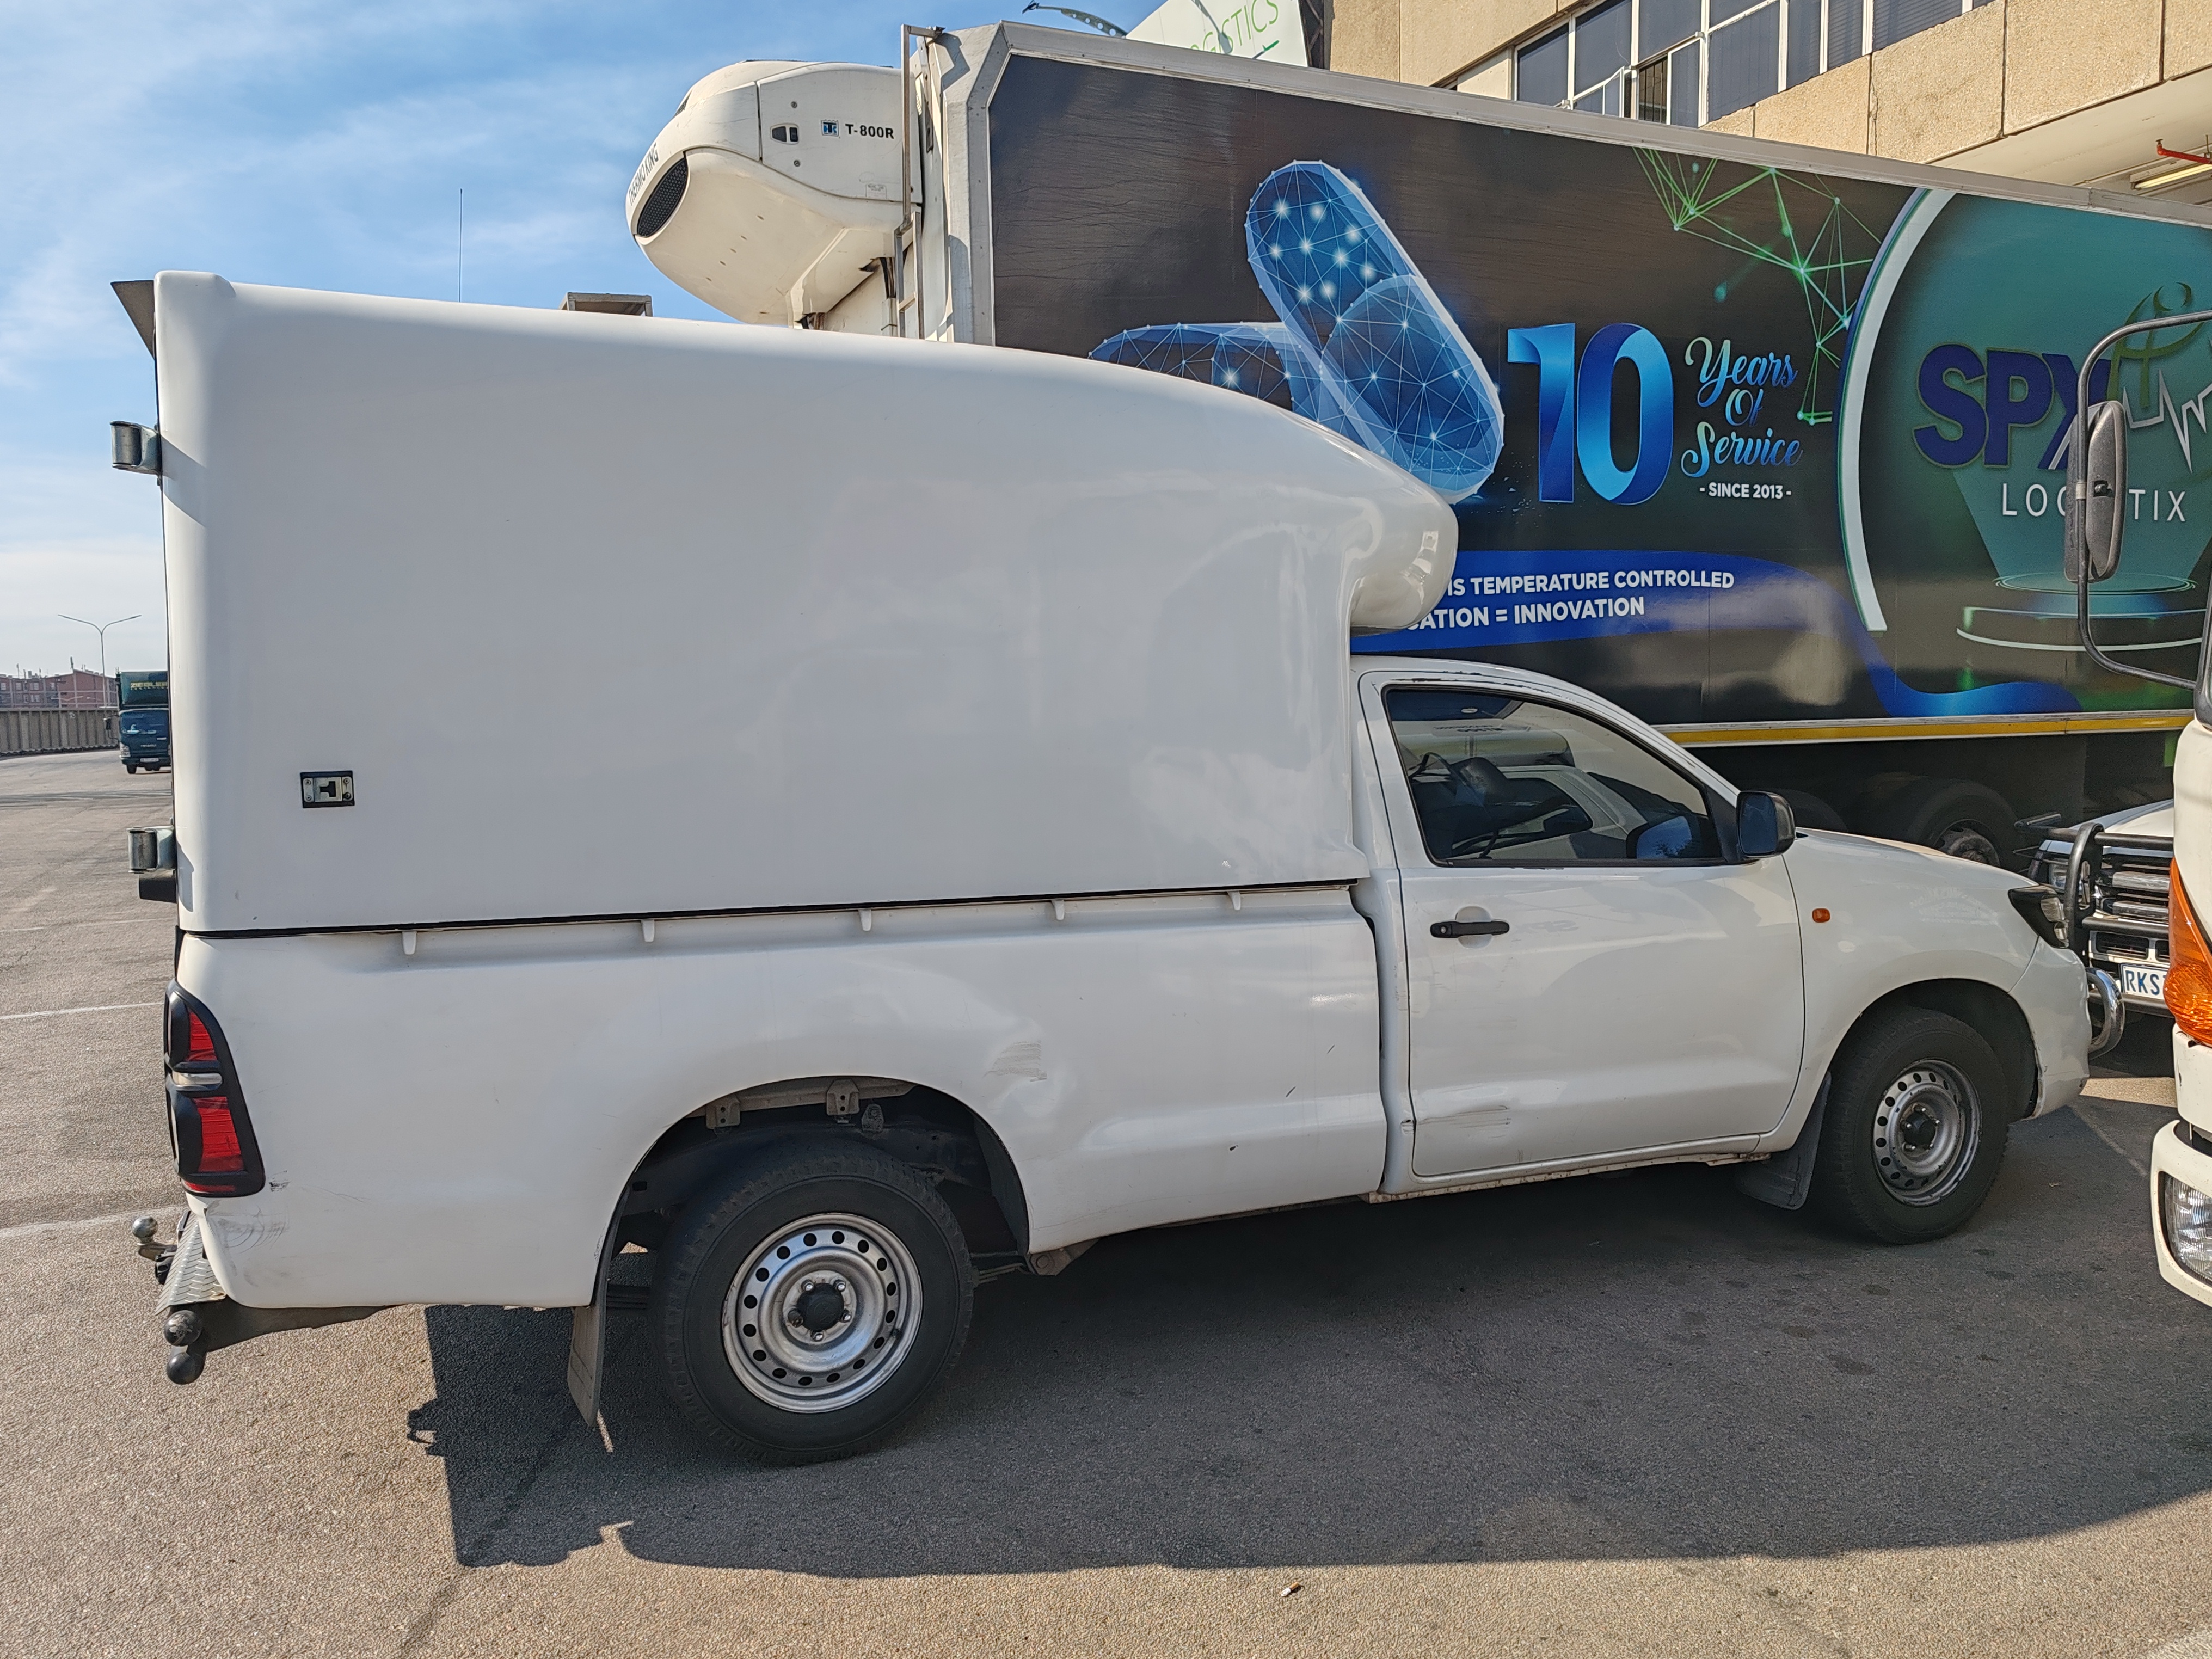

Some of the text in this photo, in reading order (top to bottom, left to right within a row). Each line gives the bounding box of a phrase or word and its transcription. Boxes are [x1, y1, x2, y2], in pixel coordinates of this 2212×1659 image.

[845, 123, 894, 139] T-800R
[628, 142, 659, 206] THERMO KING
[1685, 336, 1798, 408] Years
[1507, 322, 1674, 505] 10
[1725, 388, 1763, 427] Of
[1681, 421, 1803, 477] Service
[1708, 482, 1750, 498] SINCE
[1753, 484, 1783, 499] 2013
[1470, 572, 1609, 595] TEMPERATURE
[1614, 570, 1735, 588] CONTROLLED
[1407, 606, 1489, 630] ATION
[1514, 596, 1645, 624] INNOVATION
[2125, 970, 2167, 996] RKS
